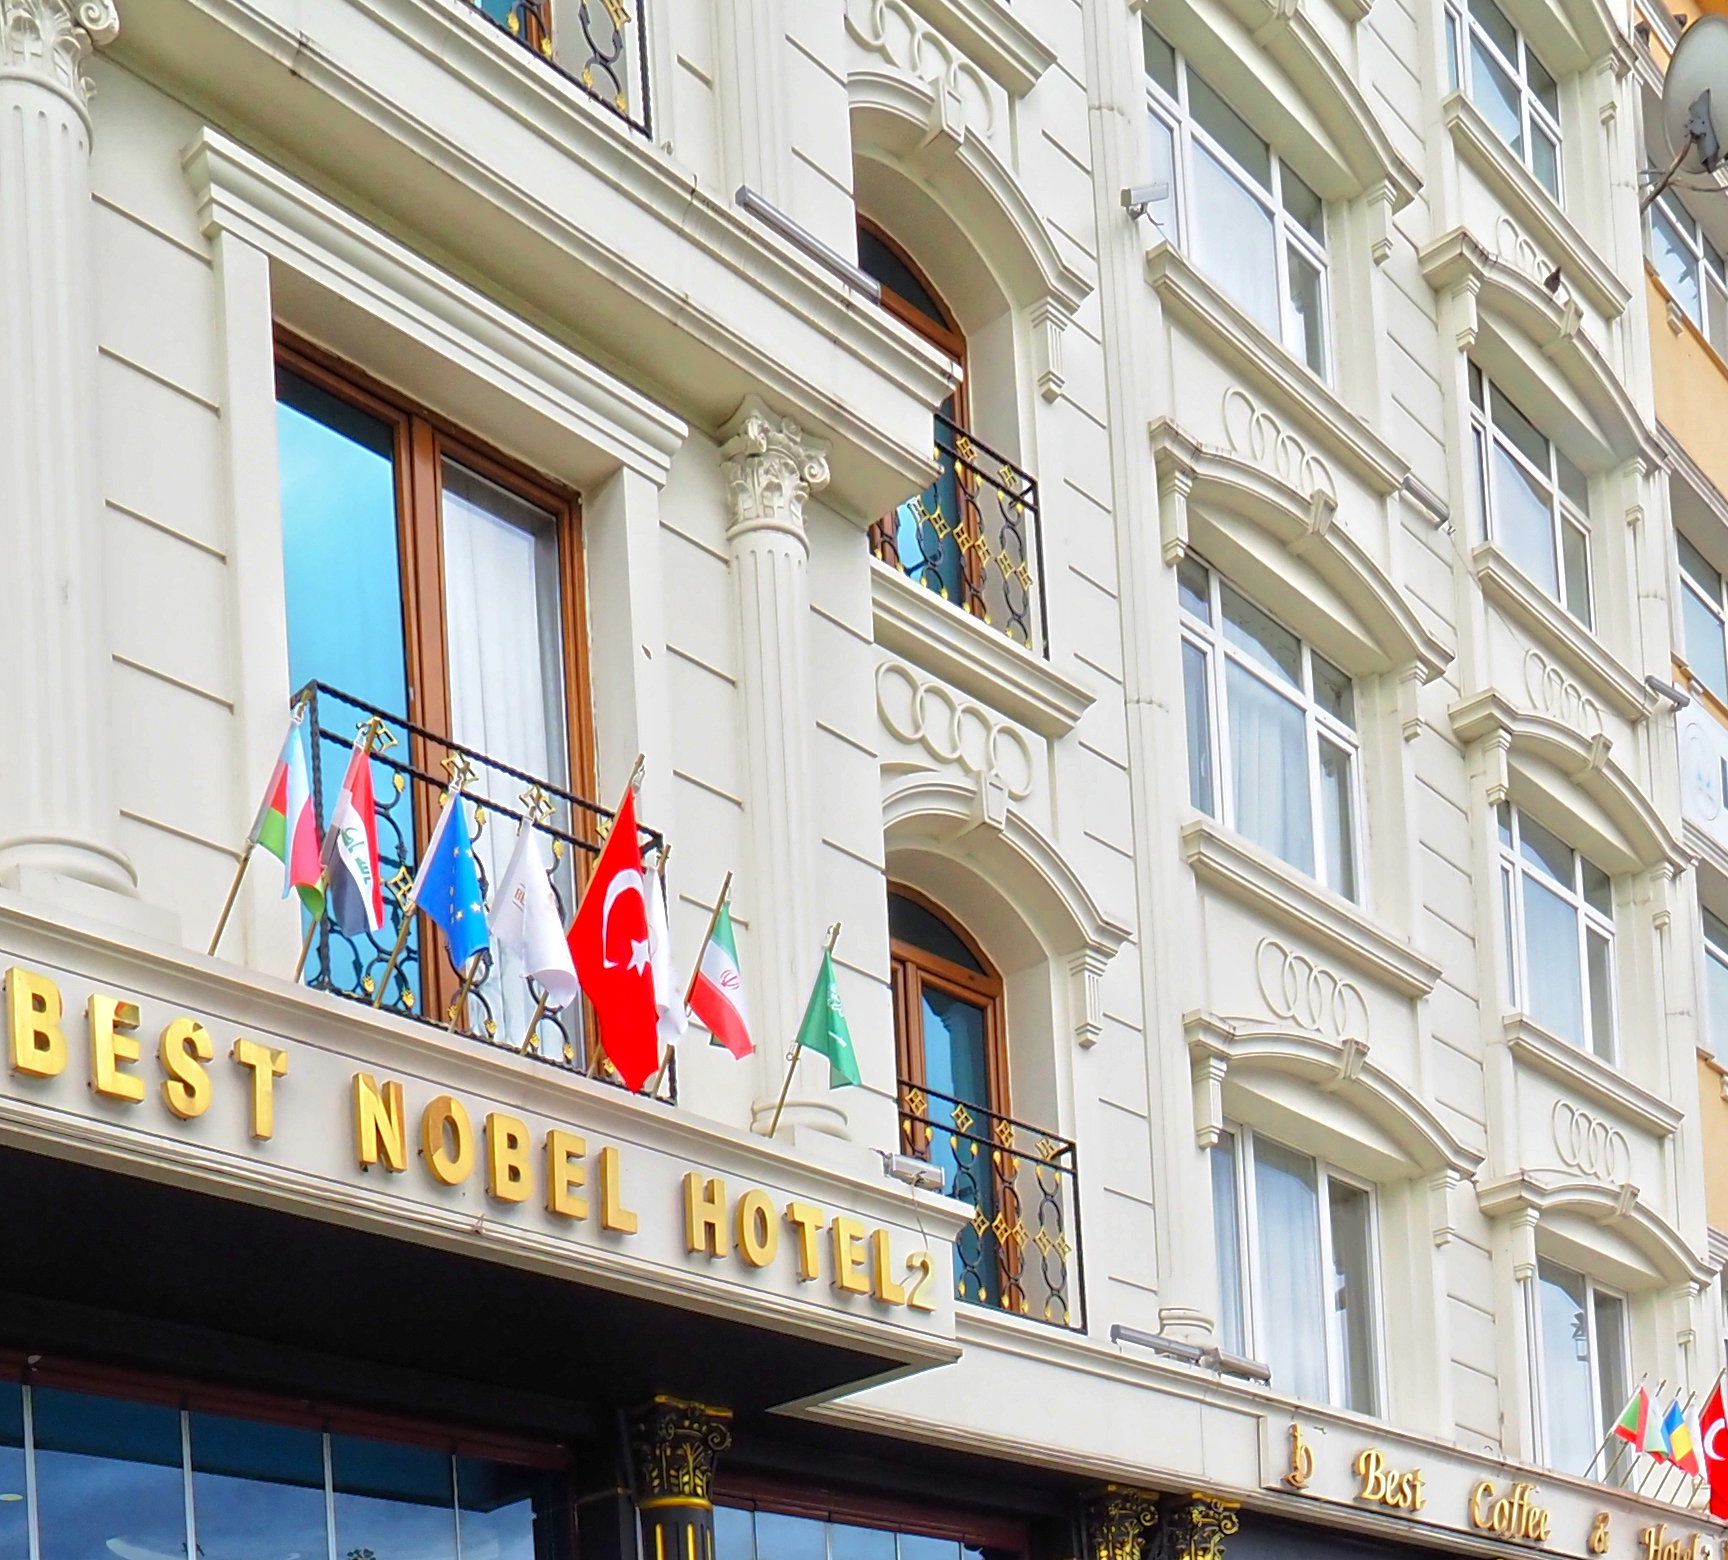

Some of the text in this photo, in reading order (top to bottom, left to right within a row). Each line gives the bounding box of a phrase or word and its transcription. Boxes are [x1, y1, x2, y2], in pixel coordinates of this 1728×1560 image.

[3, 965, 938, 1312] BEST NOBEL HOTEL 2
[1353, 1446, 1428, 1512] Best
[1470, 1480, 1552, 1541] Coffee
[1587, 1510, 1612, 1555] &
